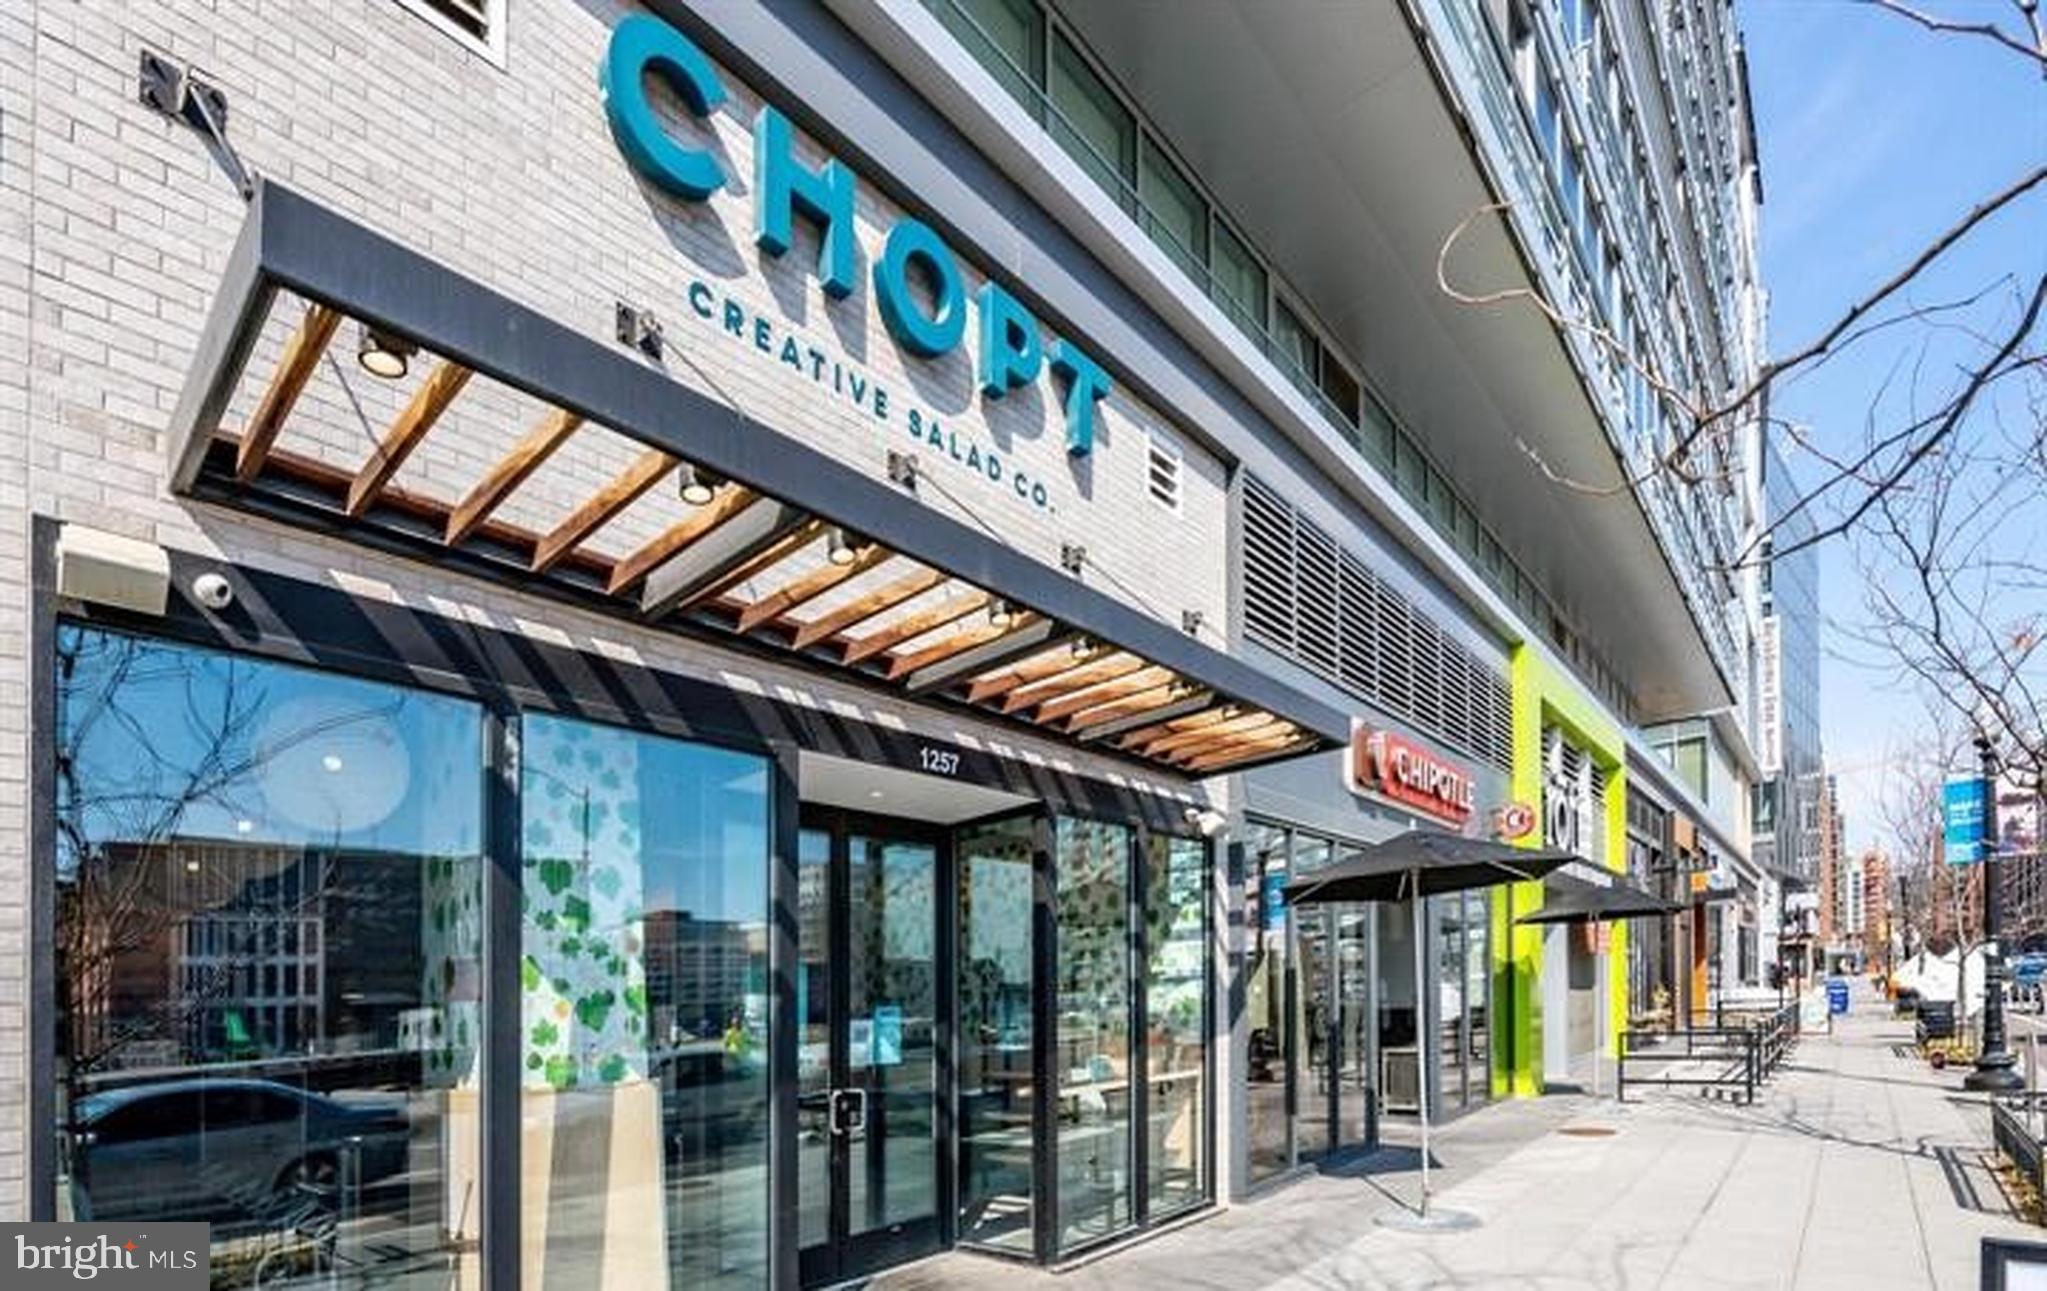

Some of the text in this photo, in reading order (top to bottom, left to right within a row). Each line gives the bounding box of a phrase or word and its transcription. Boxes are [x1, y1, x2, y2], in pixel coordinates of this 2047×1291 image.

[601, 12, 1113, 457] CHOPT
[688, 280, 1058, 514] CREATIVE SALAD CO.
[920, 746, 960, 775] 1257
[1395, 746, 1477, 811] CHIPOTLE
